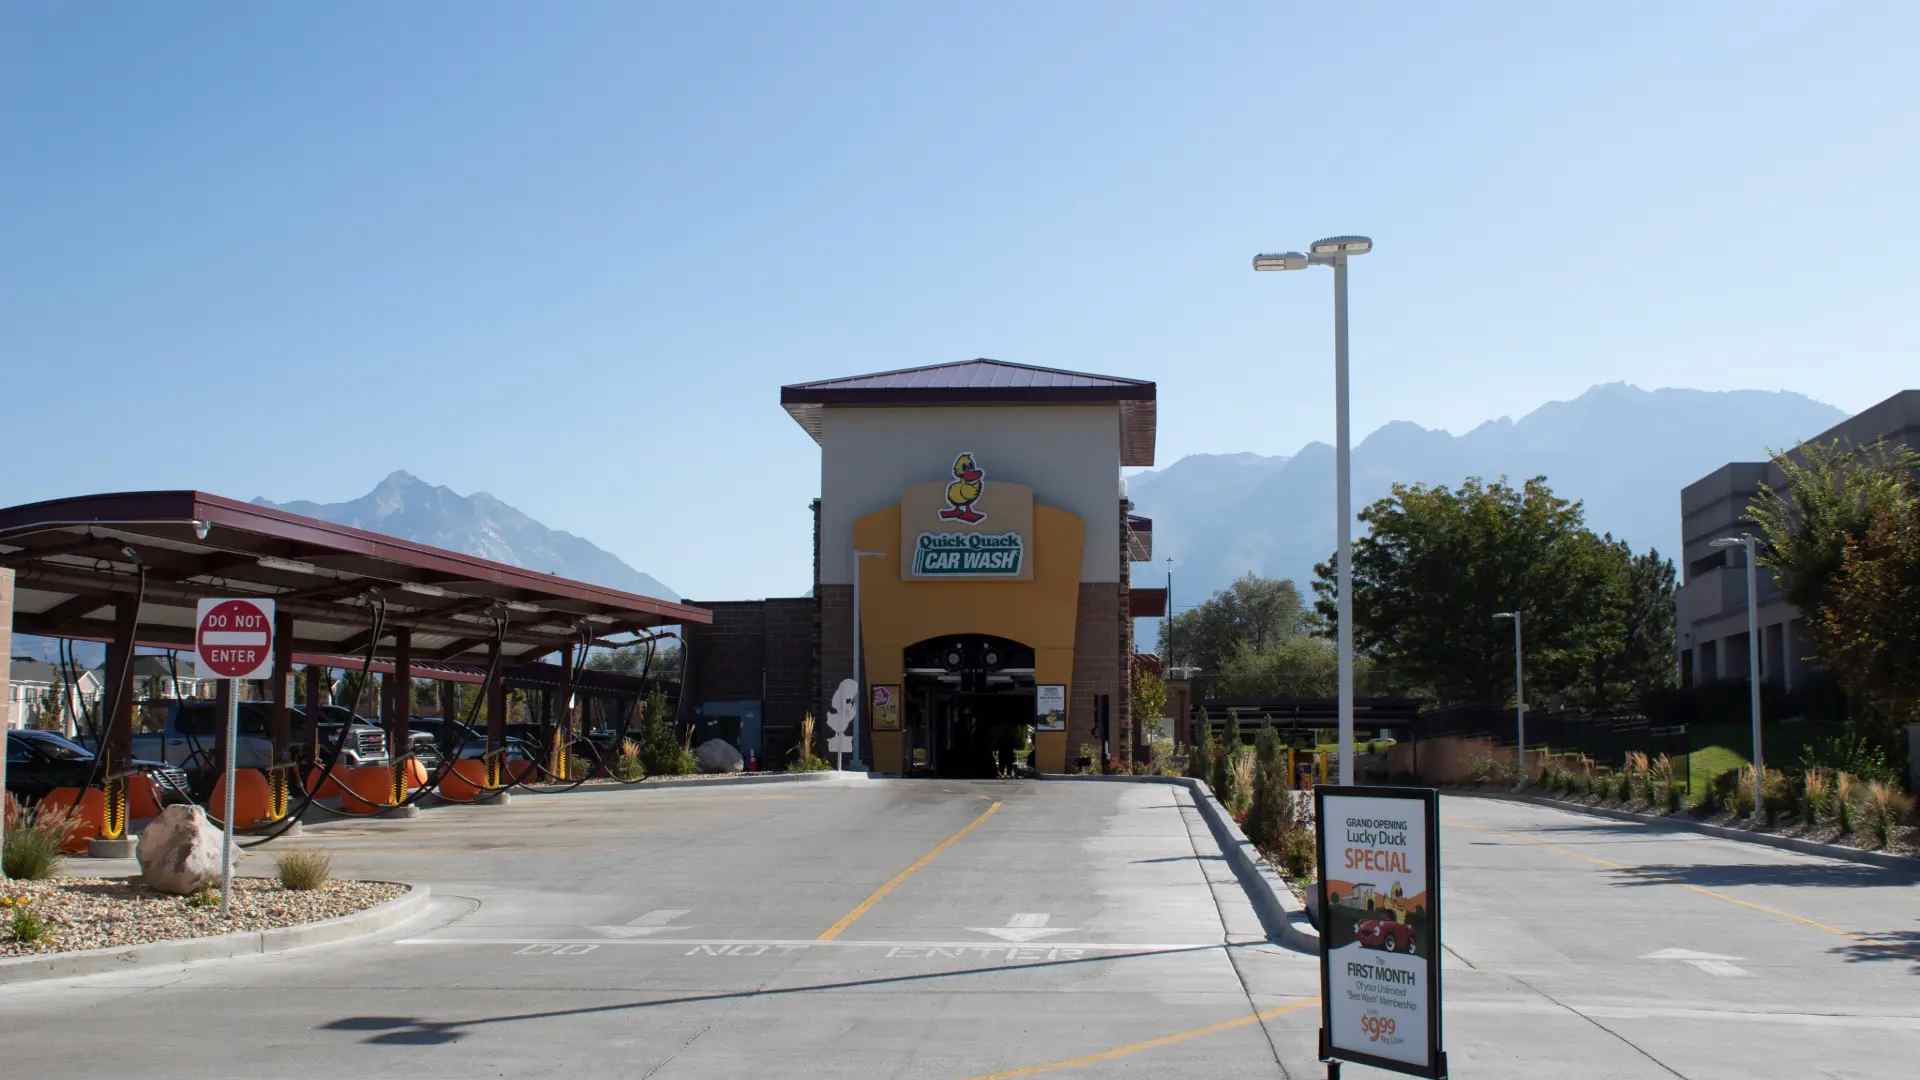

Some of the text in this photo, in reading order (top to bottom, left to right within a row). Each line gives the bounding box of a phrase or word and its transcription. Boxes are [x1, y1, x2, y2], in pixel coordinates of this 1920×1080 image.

[920, 534, 1019, 551] Quick Quack
[925, 551, 1016, 569] CAR WASH
[208, 615, 263, 628] DO NOT
[211, 649, 256, 662] ENTER
[1346, 817, 1407, 830] GRAND OPENING
[1347, 830, 1407, 847] Lucky Duck
[1344, 847, 1412, 874] SPECIAL
[512, 943, 1087, 961] DO NOT ENTER
[1347, 962, 1416, 986] FIRST MONTH
